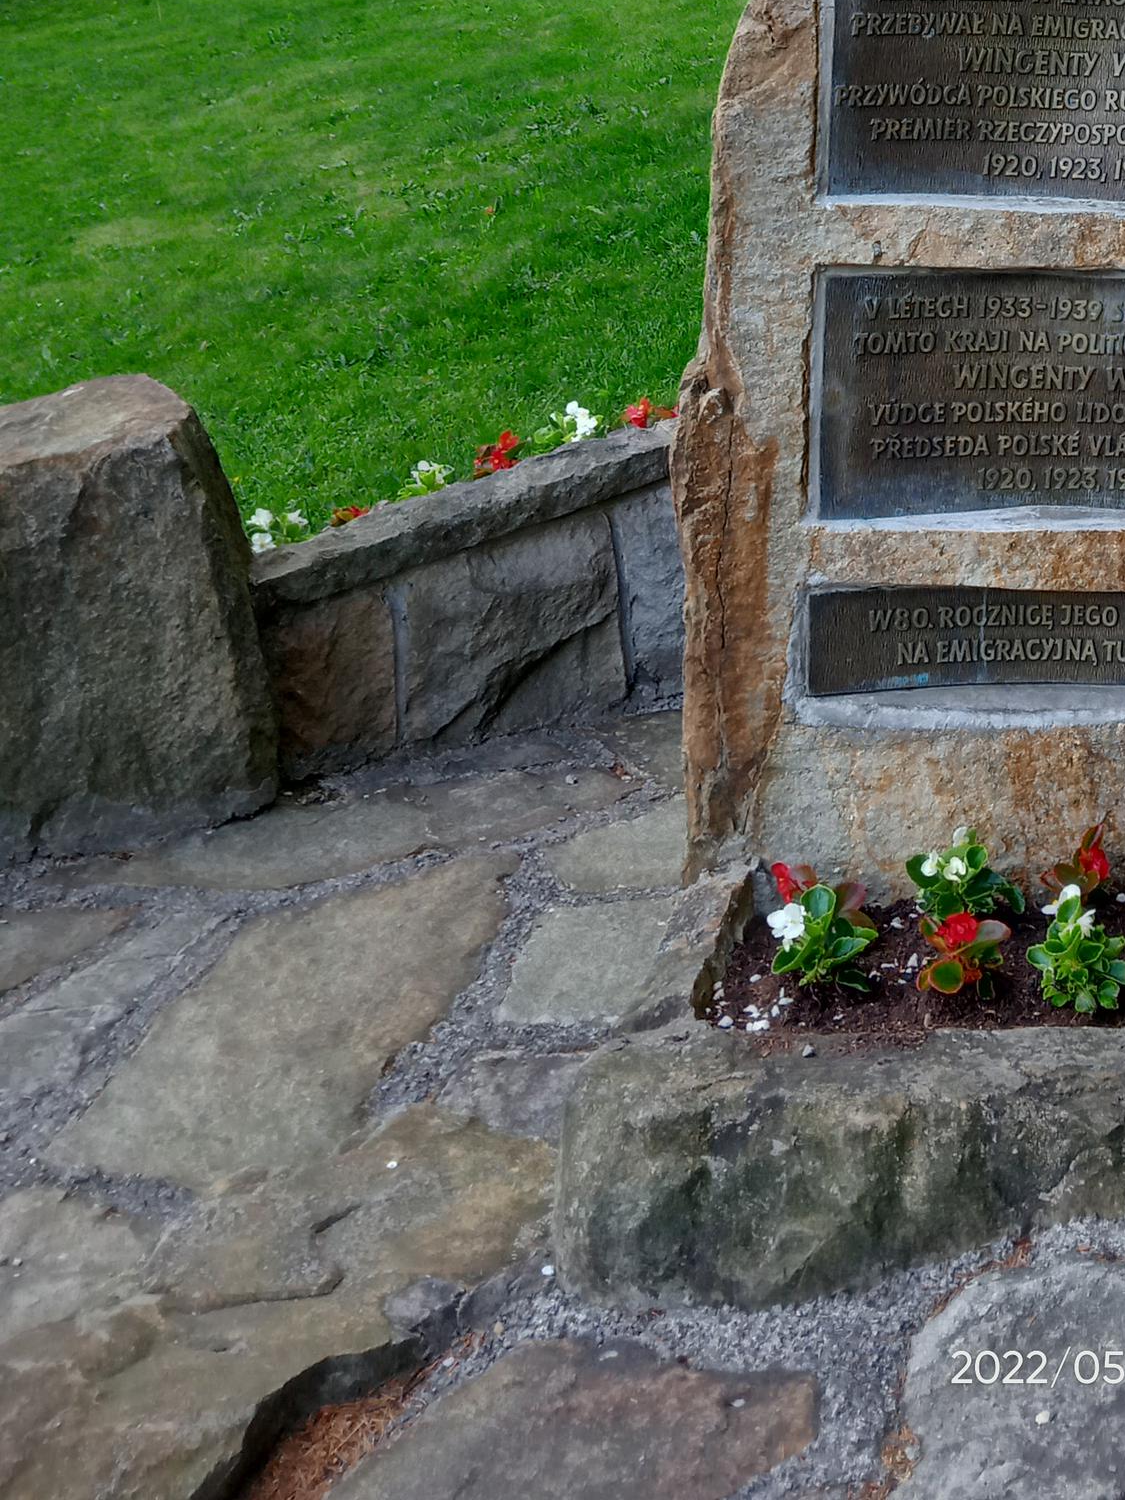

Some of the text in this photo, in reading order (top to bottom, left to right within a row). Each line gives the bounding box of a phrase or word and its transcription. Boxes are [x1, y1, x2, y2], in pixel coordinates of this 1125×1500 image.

[851, 12, 986, 37] PRZEBYWAŁ
[991, 13, 1024, 36] NA
[958, 46, 1100, 77] WINCENTY
[834, 77, 972, 107] PRZYWÓDCA
[976, 84, 1096, 111] POLSKIEGO
[870, 117, 971, 141] PREMIER
[982, 154, 1042, 179] 1920,
[1049, 156, 1108, 183] 1923,
[865, 298, 881, 320] V
[979, 297, 1103, 322] 1933-1939
[855, 331, 936, 356] TOMTO
[944, 331, 1009, 353] KRAJI
[1019, 331, 1050, 353] NA
[952, 364, 1097, 391] WINCENTY
[950, 397, 1067, 423] POLSKÉHO
[870, 432, 989, 460] PŘEDSEDA
[997, 431, 1081, 457] POLSKÉ
[977, 468, 1037, 491] 1920,
[1043, 467, 1101, 492] 1923,
[938, 604, 1054, 630] ROCZNICĘ
[1060, 604, 1118, 627] JEGO
[897, 641, 930, 665] NA
[936, 637, 1098, 666] EMIGRACYJNĄ
